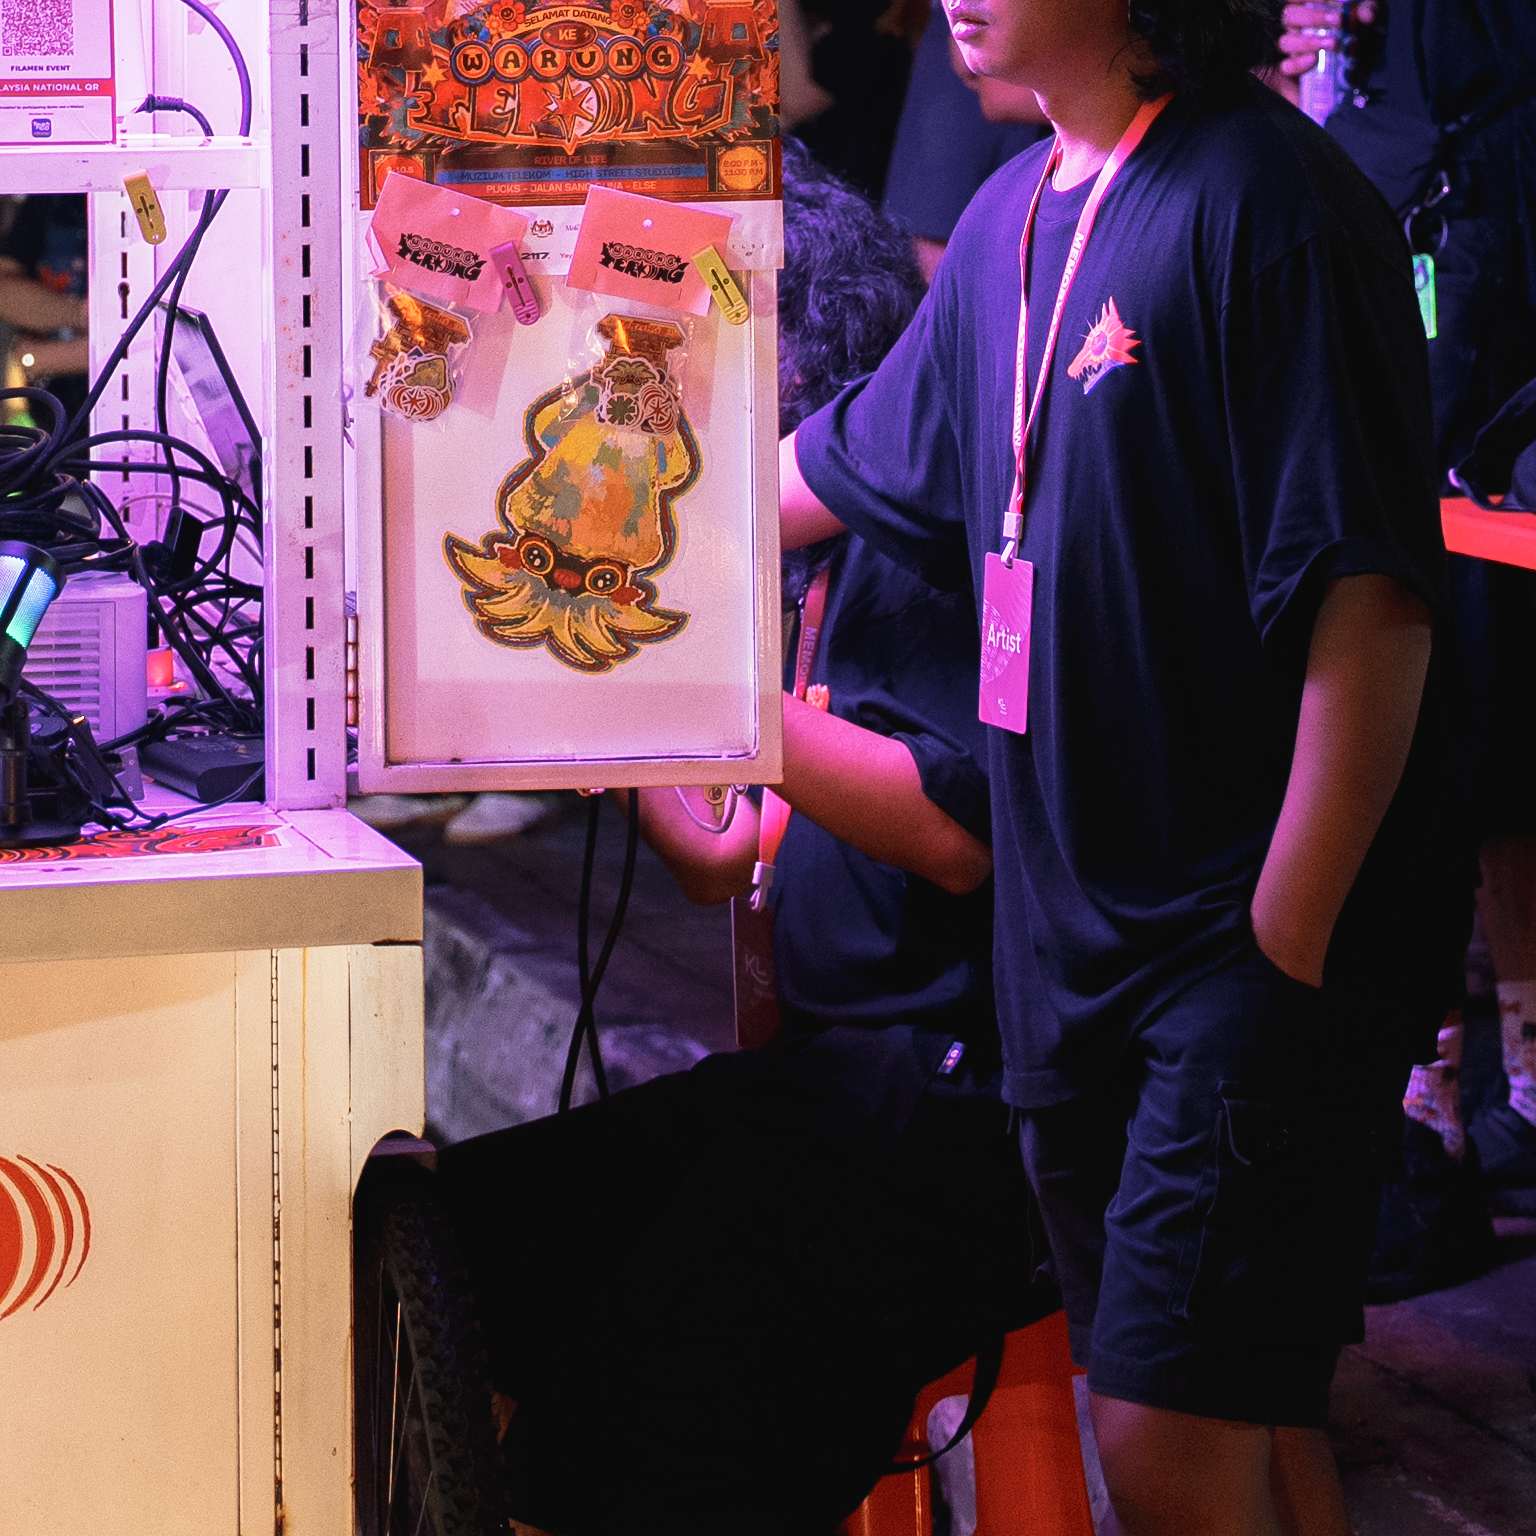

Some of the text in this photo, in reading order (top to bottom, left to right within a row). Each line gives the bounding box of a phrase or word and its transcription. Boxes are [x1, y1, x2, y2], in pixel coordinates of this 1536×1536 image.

[524, 9, 613, 27] SELAMAT DATANG
[558, 28, 577, 41] KE
[462, 44, 674, 73] WARUNG
[33, 83, 82, 92] NATIONAL
[85, 83, 99, 91] QR
[486, 184, 521, 194] PUCKS
[530, 183, 563, 193] JALAN
[632, 181, 657, 190] ELSE
[410, 238, 472, 262] WARUNG
[613, 246, 674, 265] WARUNG
[987, 623, 1022, 654] Artist
